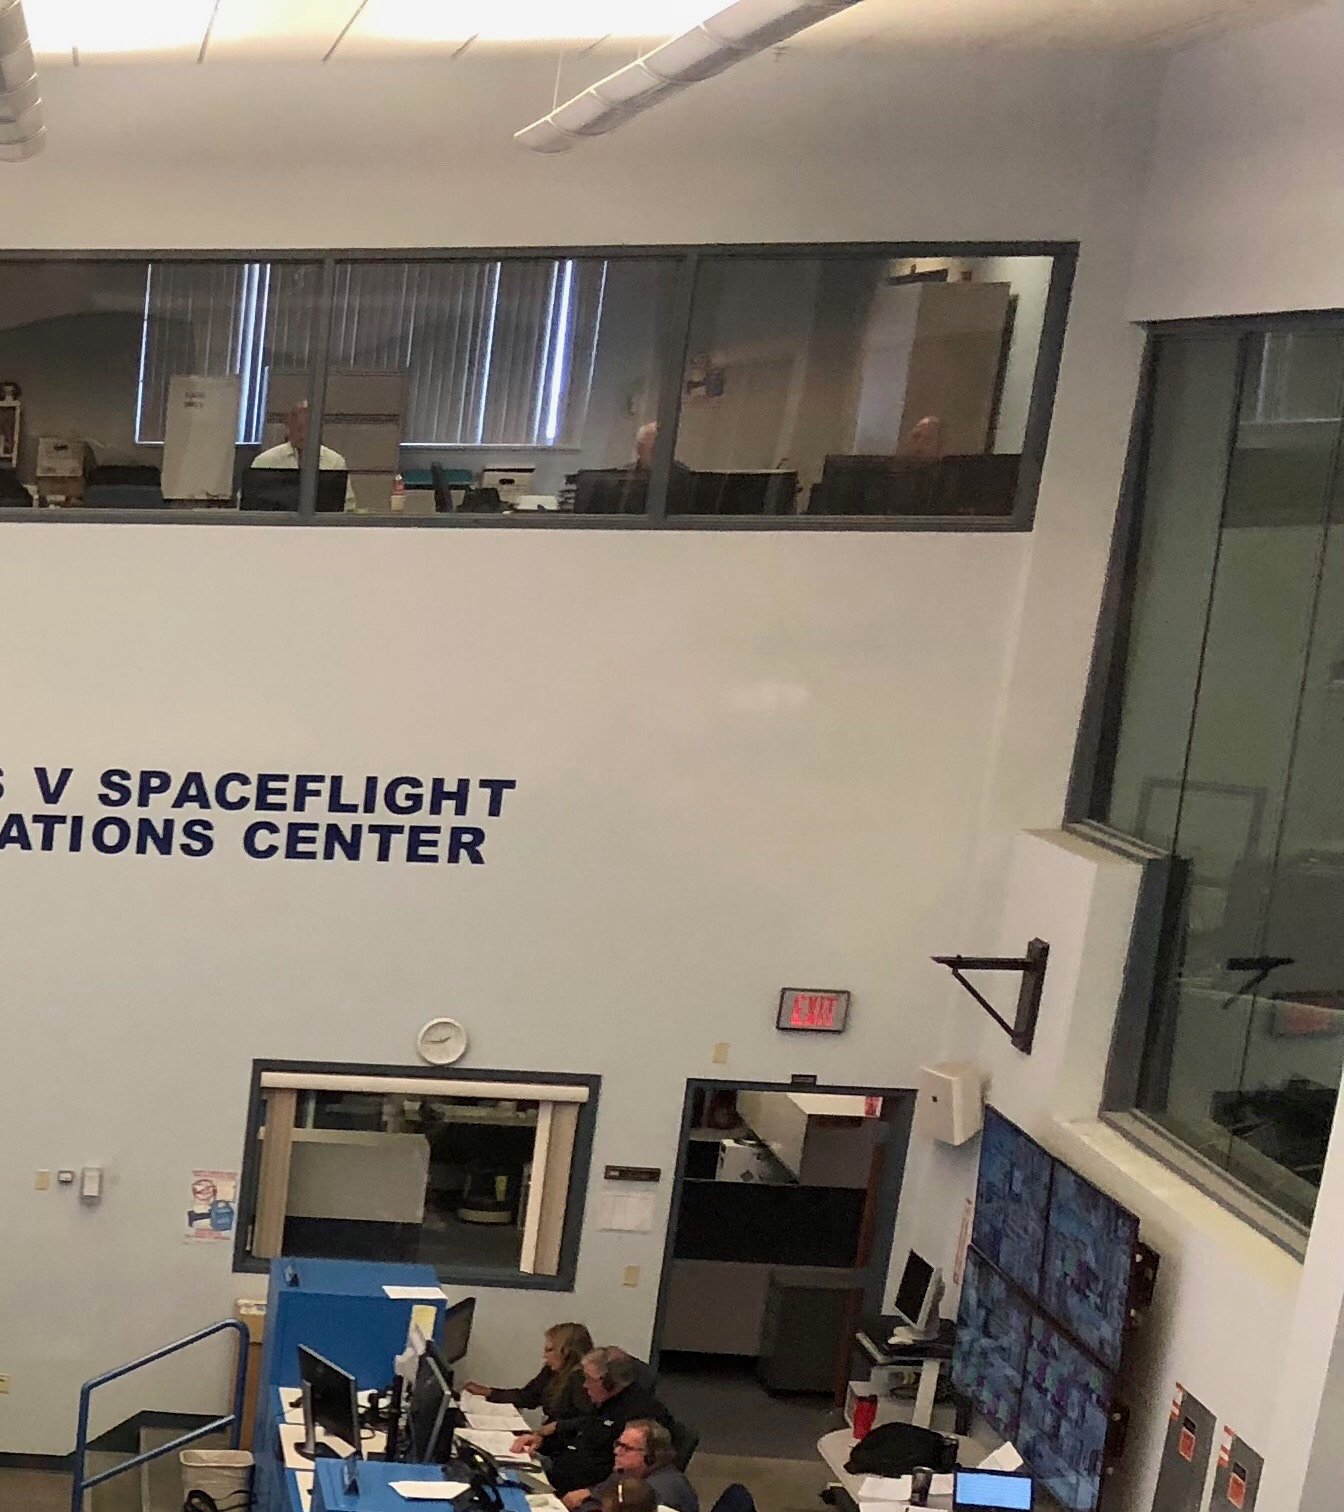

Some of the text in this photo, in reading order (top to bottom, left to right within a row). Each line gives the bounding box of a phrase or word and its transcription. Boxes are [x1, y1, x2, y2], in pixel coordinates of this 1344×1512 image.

[33, 766, 73, 805] V
[97, 768, 517, 818] SPACEFLIGHT
[242, 820, 486, 865] CENTER
